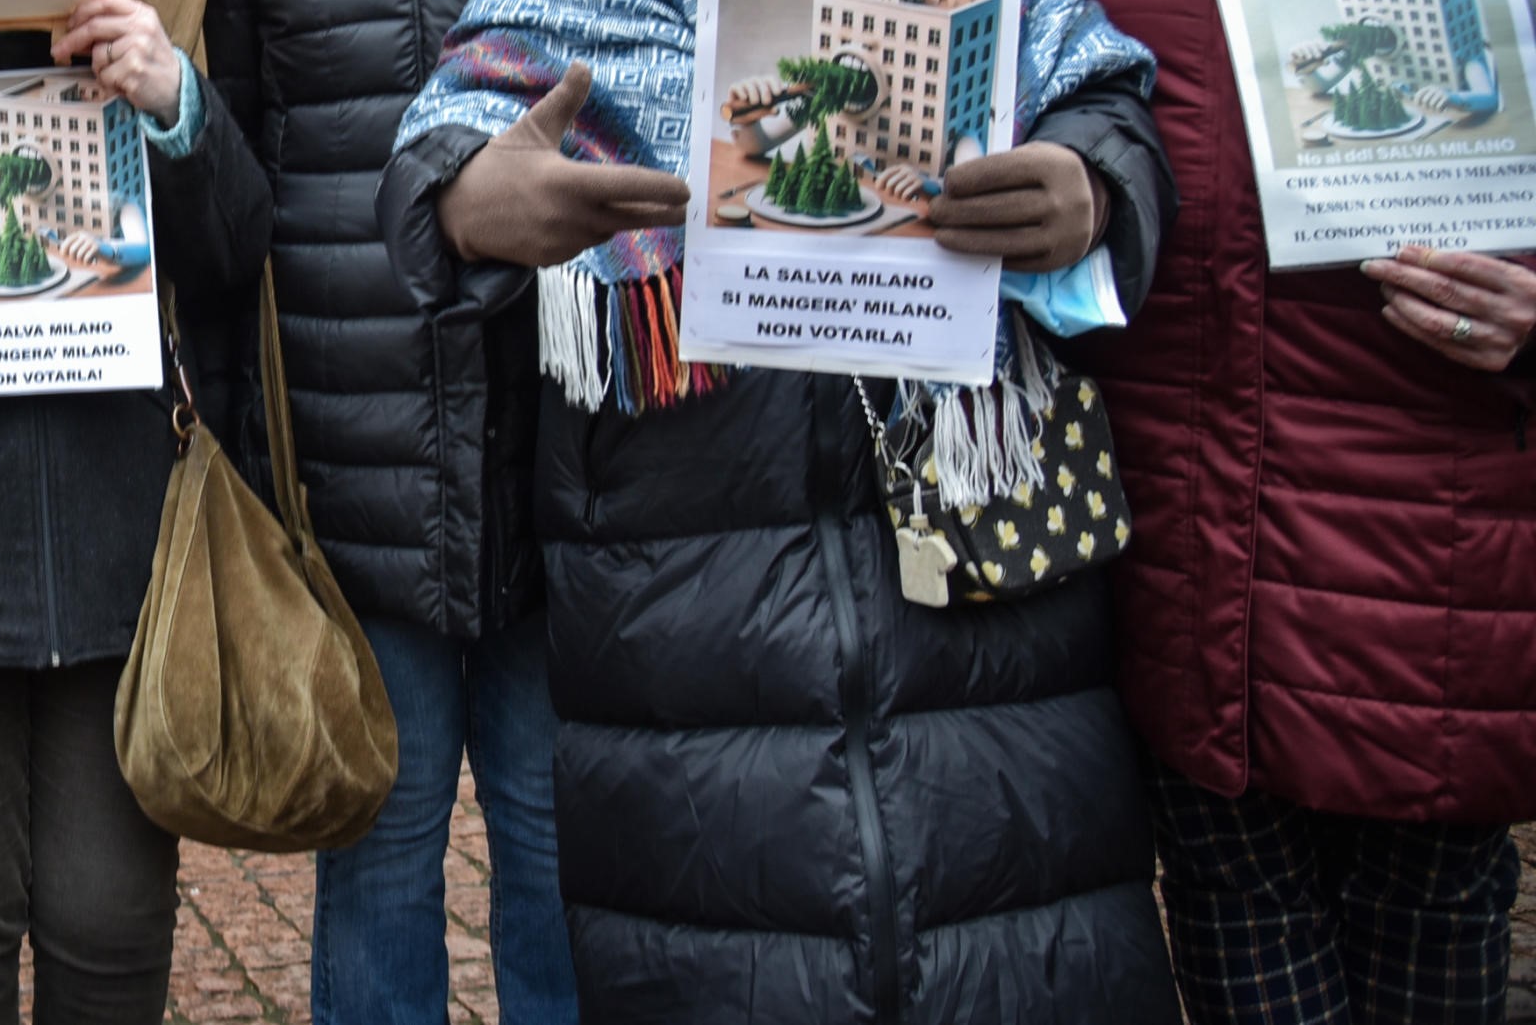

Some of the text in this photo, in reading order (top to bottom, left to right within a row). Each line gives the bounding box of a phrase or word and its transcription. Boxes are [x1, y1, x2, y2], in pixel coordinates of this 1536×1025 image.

[1297, 151, 1321, 167] No
[1377, 141, 1438, 160] SALVA
[1441, 137, 1515, 155] MILANO
[1286, 176, 1320, 189] CHE
[1323, 173, 1370, 186] SALVA
[1374, 171, 1414, 184] SALA
[1418, 168, 1452, 181] NON
[1305, 190, 1533, 215] NESSUN CONDONO A MILANO
[1294, 230, 1311, 243] IL
[1313, 220, 1395, 241] CONDONO
[1399, 220, 1450, 235] VIOLA
[745, 265, 934, 290] LA SALVA MILANO
[722, 290, 952, 321] SI MANGERA' MILANO.
[49, 321, 112, 336] MILANO
[757, 322, 912, 346] NON VOTARLA!
[63, 344, 130, 359] MILANO.
[23, 369, 102, 384] VOTARLA!
